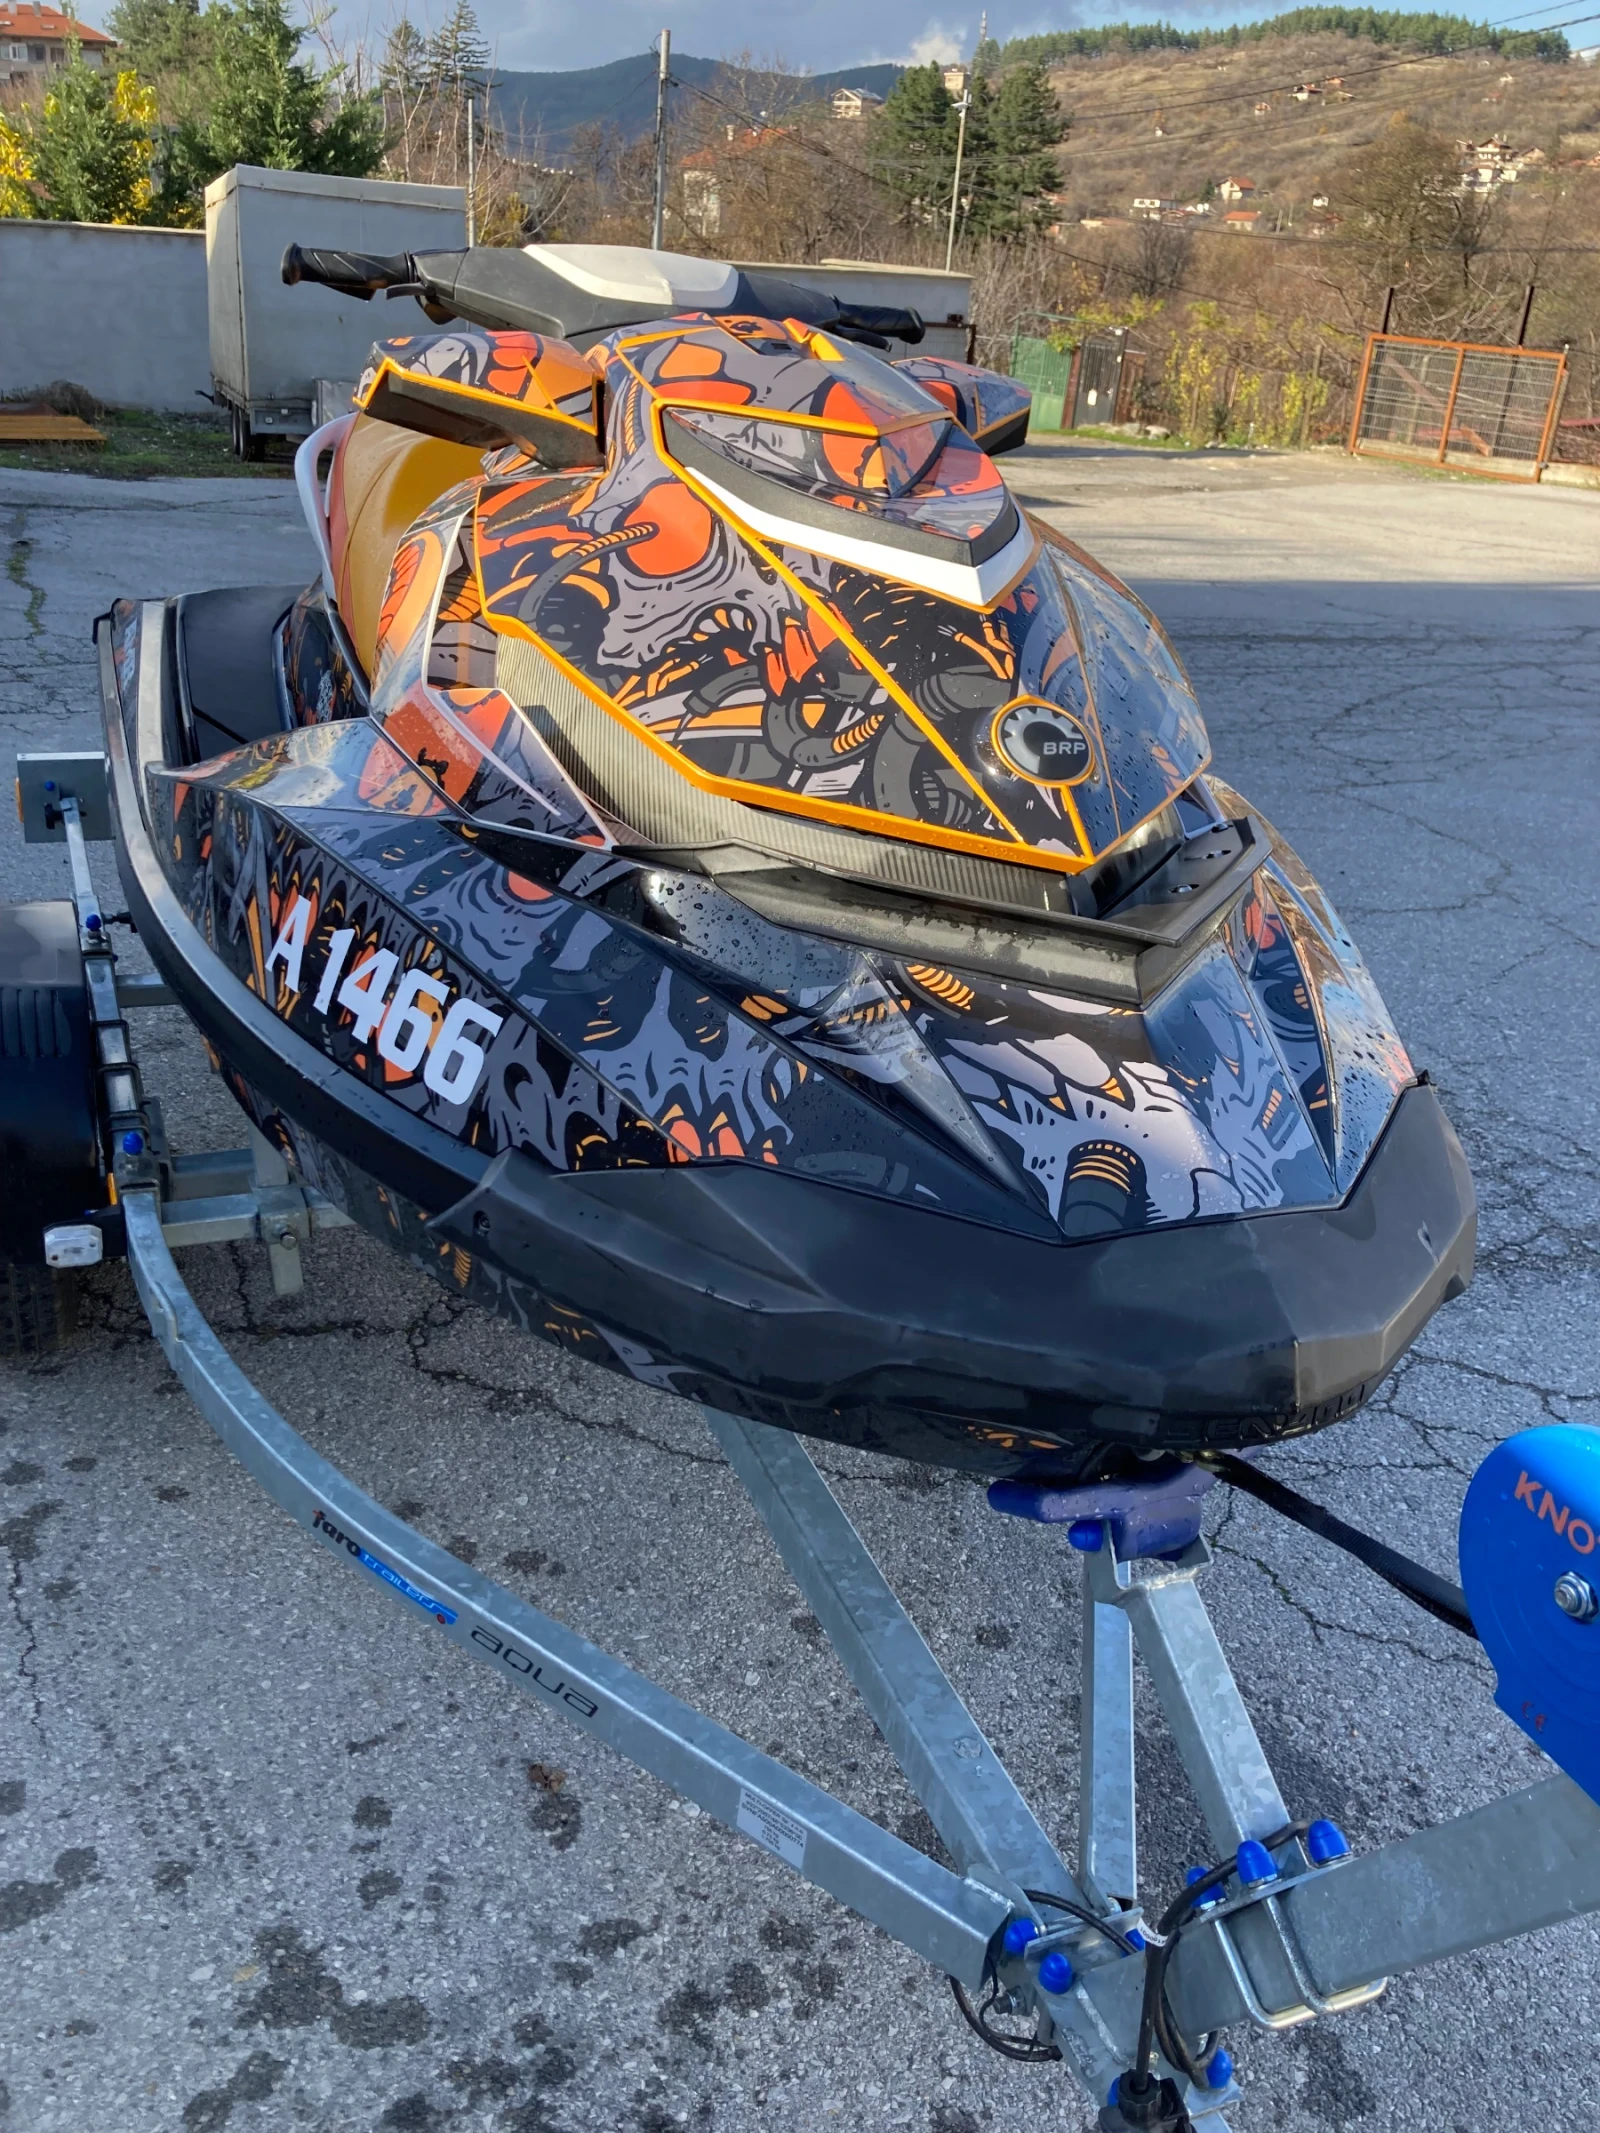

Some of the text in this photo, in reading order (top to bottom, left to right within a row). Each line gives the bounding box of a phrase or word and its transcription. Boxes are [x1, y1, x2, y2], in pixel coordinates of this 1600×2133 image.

[1042, 741, 1086, 756] BRP
[1514, 1469, 1600, 1555] KNO
[471, 1625, 598, 1718] aqua
